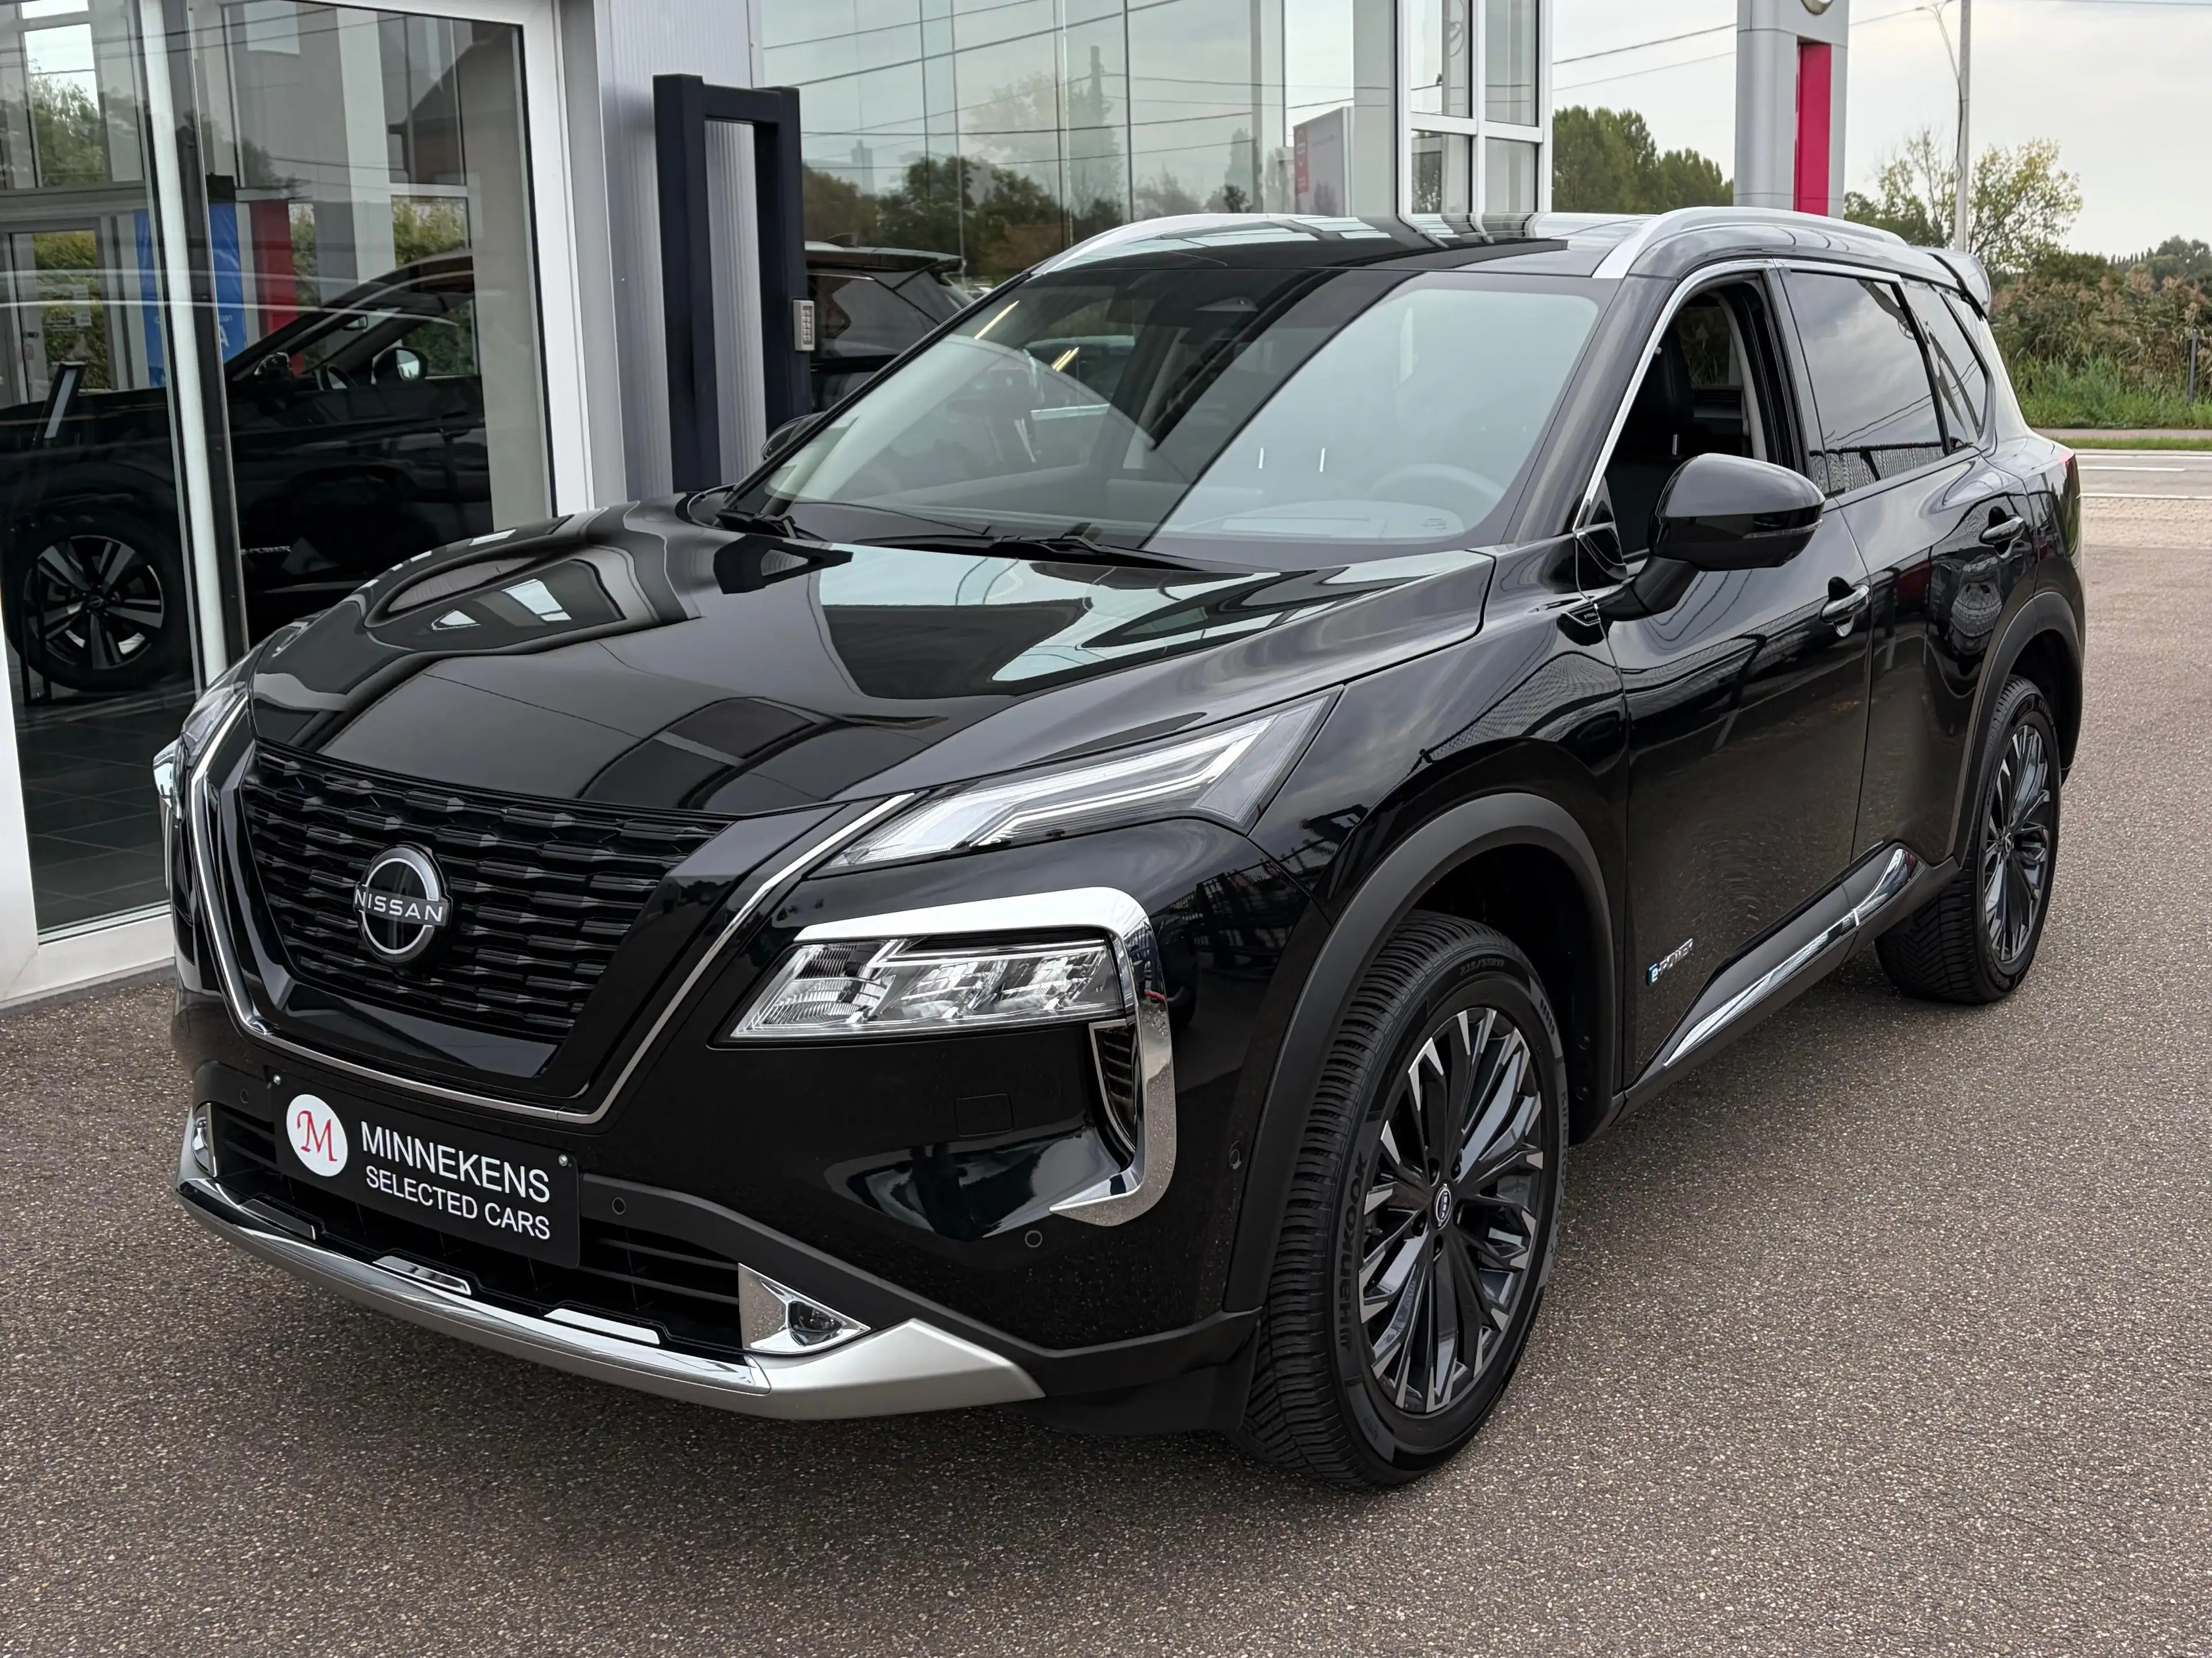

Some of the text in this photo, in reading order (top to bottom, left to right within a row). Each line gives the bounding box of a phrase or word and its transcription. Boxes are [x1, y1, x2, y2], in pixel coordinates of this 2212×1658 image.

[354, 889, 443, 922] NISSAN
[297, 1110, 338, 1162] M
[361, 1121, 550, 1203] MINNEKENS
[366, 1165, 550, 1240] SELECTED CARS
